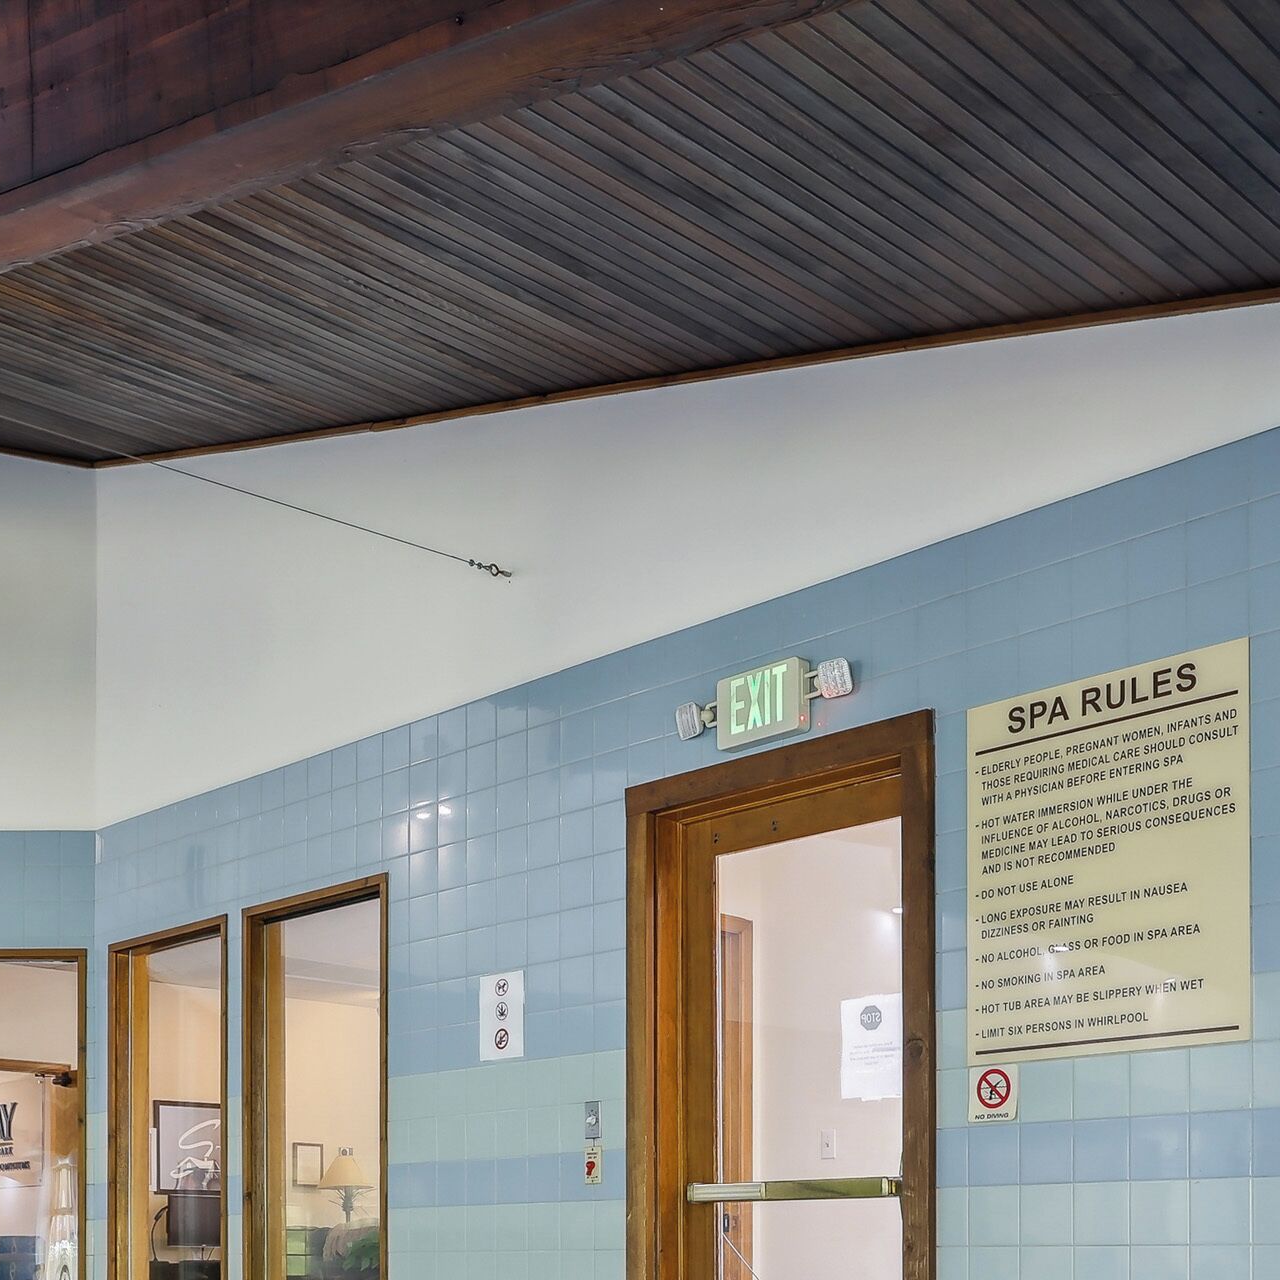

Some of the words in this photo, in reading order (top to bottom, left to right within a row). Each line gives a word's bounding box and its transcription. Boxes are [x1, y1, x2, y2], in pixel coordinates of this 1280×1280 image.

[731, 664, 787, 735] EXIT
[1008, 696, 1069, 734] SPA
[1081, 663, 1197, 717] RULES
[981, 757, 1020, 776] ELDERLY
[1066, 735, 1118, 757] PREGNANT
[1167, 714, 1210, 734] INFANTS
[1214, 708, 1237, 724] AND
[982, 776, 1010, 791] THOSE
[1014, 764, 1064, 784] REQUIRING
[1068, 754, 1110, 772] MEDICAL
[1113, 747, 1139, 763] CARE
[1143, 737, 1185, 756] SHOULD
[1189, 725, 1239, 746] CONSULT
[982, 793, 1003, 806] WITH
[1006, 791, 1012, 801] A
[1014, 780, 1063, 799] PHYSICIAN
[1067, 771, 1105, 788] BEFORE
[1109, 760, 1159, 779] ENTERING
[1163, 754, 1183, 768] SPA
[981, 817, 999, 830] HOT
[1003, 810, 1034, 825] WATER
[1038, 798, 1092, 818] IMMERSION
[1097, 791, 1128, 807] WHILE
[1132, 783, 1168, 800] UNDER
[1172, 778, 1192, 792] THE
[981, 825, 1033, 844] INFLUENCE
[1036, 822, 1048, 834] OF
[1173, 791, 1211, 808] DRUGS
[1215, 787, 1231, 800] OR
[981, 842, 1025, 860] MEDICINE
[1029, 838, 1047, 851] MAY
[1052, 833, 1076, 847] LEAD
[1080, 830, 1093, 841] TO
[1096, 821, 1141, 839] SERIOUS
[1145, 803, 1236, 830] CONSEQUENCES
[982, 863, 1000, 875] AND
[1004, 861, 1012, 871] IS
[1016, 857, 1034, 869] NOT
[1038, 842, 1116, 865] RECOMMENDED
[981, 888, 994, 900] DO
[998, 885, 1016, 897] NOT
[1019, 881, 1037, 893] USE
[1040, 875, 1074, 890] ALONE
[981, 911, 1006, 924] LONG
[1010, 902, 1061, 920] EXPOSURE
[1065, 898, 1084, 911] MAY
[1088, 892, 1126, 908] RESULT
[1130, 890, 1139, 901] IN
[1144, 882, 1188, 899] NAUSEA
[981, 923, 1028, 939] DIZZINESS
[1032, 921, 1045, 932] OR
[1049, 913, 1094, 930] FAINTING
[981, 953, 994, 964] NO
[1083, 938, 1098, 950] OR
[1102, 934, 1130, 947] FOOD
[1134, 932, 1143, 943] IN
[1147, 928, 1167, 941] SPA
[1170, 924, 1200, 938] AREA
[981, 979, 994, 990] NO
[997, 973, 1040, 988] SMOKING
[1044, 972, 1052, 982] IN
[1056, 969, 1075, 981] SPA
[1077, 966, 1106, 978] AREA
[981, 1003, 999, 1014] HOT
[1003, 1000, 1021, 1012] TUB
[1024, 997, 1050, 1009] AREA
[1053, 994, 1073, 1006] MAY
[1076, 992, 1089, 1003] BE
[1092, 986, 1141, 1002] SLIPPERY
[1145, 982, 1176, 996] WHEN
[1180, 979, 1204, 992] WET
[981, 1028, 1004, 1039] LIMIT
[1008, 1026, 1022, 1036] SIX
[1025, 1020, 1071, 1034] PERSONS
[1075, 1019, 1084, 1029] IN
[1087, 1012, 1148, 1028] WHIRLPOOL
